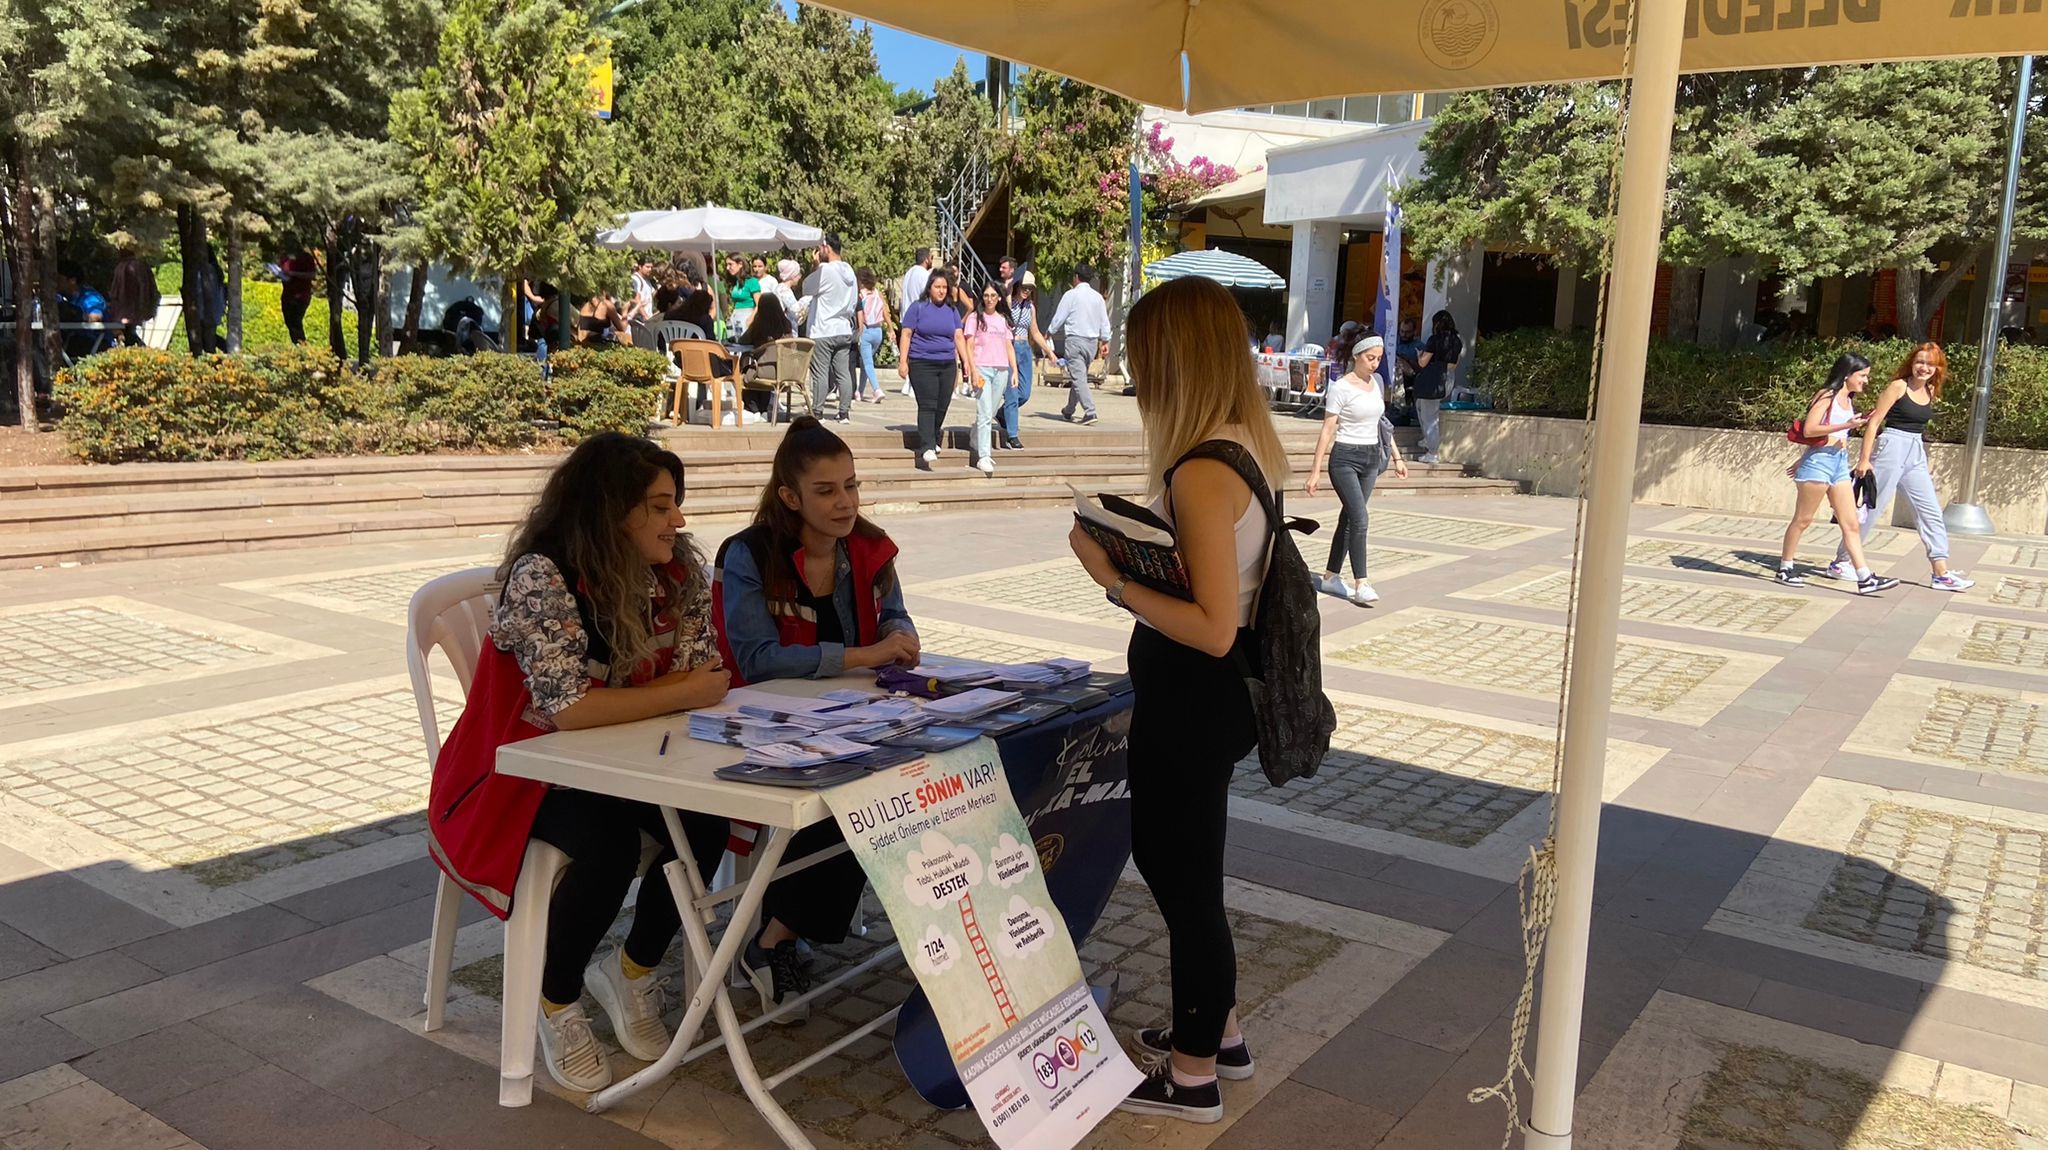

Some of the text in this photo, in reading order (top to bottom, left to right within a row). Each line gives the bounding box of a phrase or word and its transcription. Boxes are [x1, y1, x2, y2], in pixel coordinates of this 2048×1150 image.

[1064, 760, 1094, 786] EL
[848, 806, 876, 834] BU
[874, 792, 916, 824] İLDE
[915, 772, 965, 813] ŞÖNİM
[963, 762, 997, 789] VAR!
[869, 791, 997, 853] Şiddet Önleme ve İzleme Merkezi
[997, 861, 1029, 881] Yönlendirme
[932, 872, 969, 900] DESTEK
[1008, 918, 1040, 939] Yönlendirme
[924, 938, 945, 957] 7/24
[1080, 1029, 1096, 1046] 112
[1037, 1061, 1054, 1081] 183
